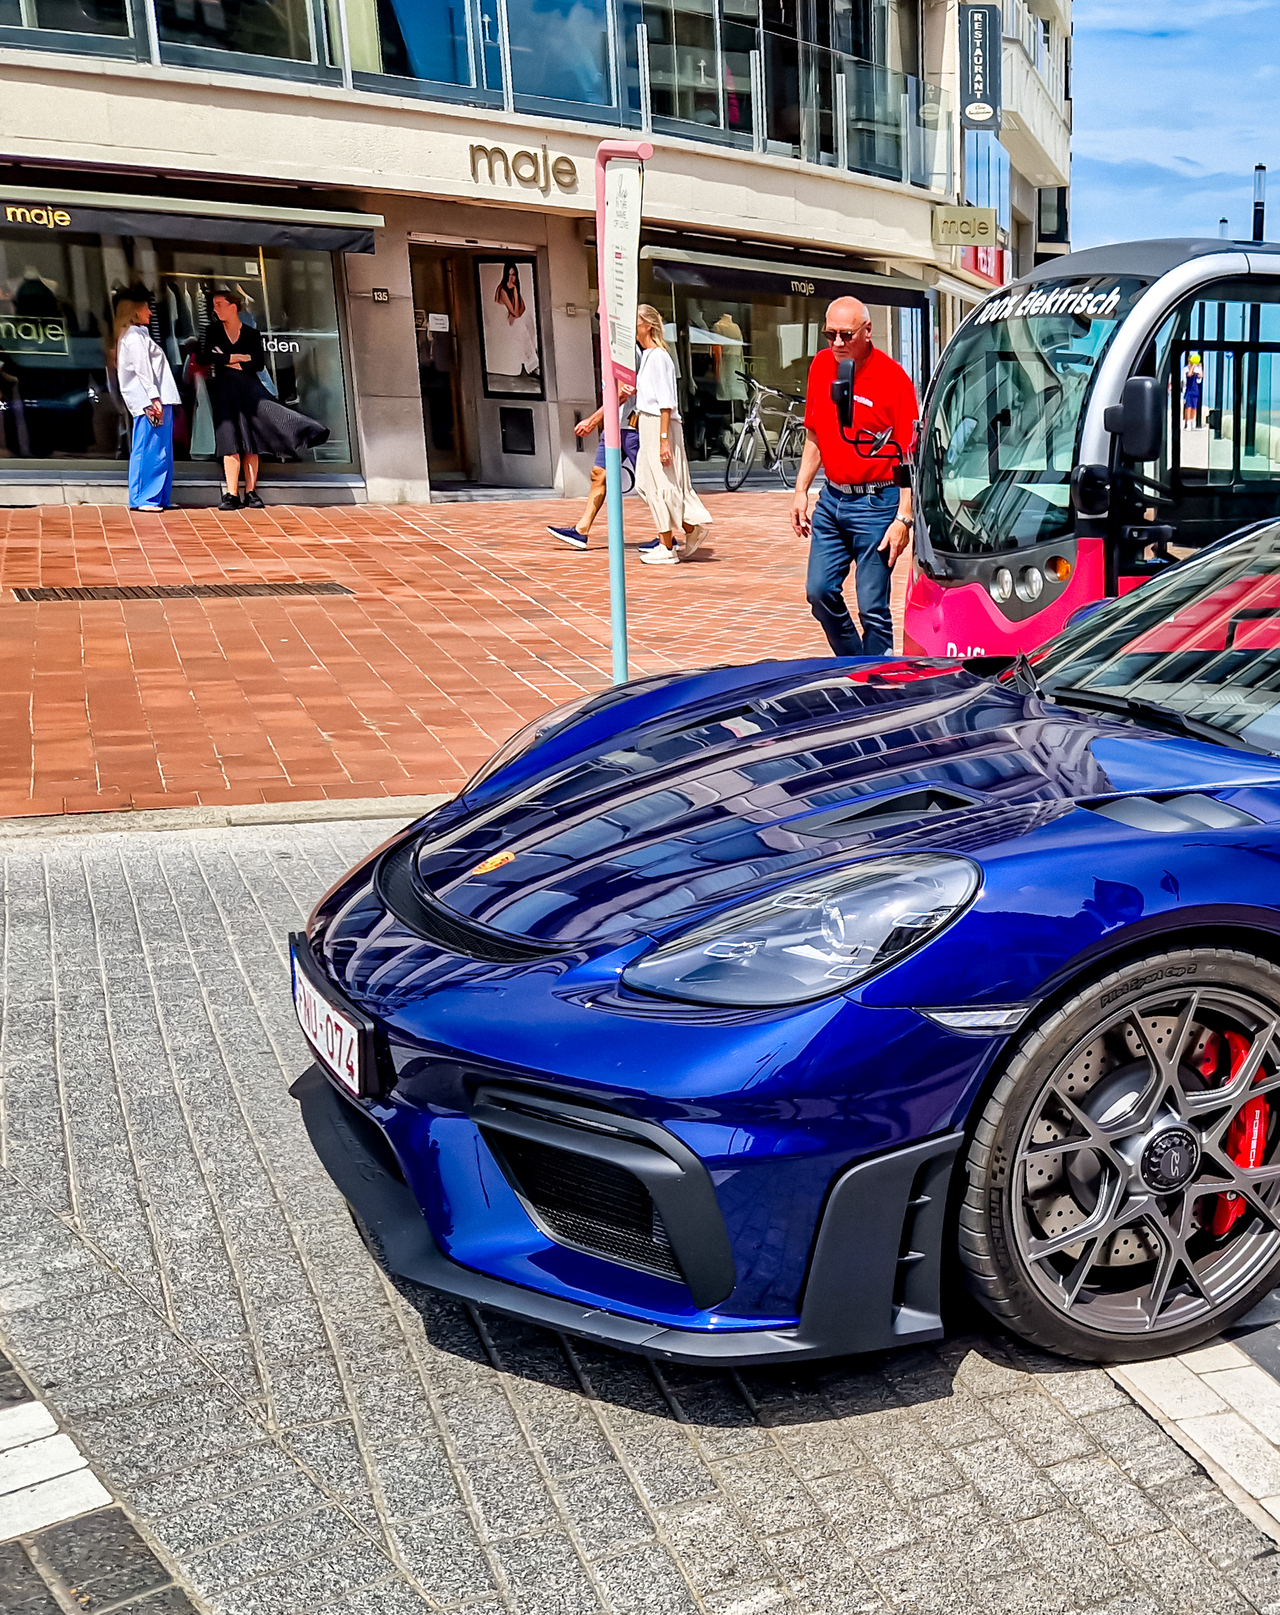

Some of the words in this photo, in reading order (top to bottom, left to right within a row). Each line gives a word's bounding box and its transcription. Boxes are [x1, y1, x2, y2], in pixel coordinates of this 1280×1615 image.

[973, 12, 984, 99] RESTAURANT
[468, 143, 578, 193] maje
[5, 205, 72, 229] maje
[940, 217, 990, 239] maje
[373, 291, 389, 302] 135
[790, 279, 816, 297] maje
[973, 292, 1023, 326] 100%
[1014, 286, 1122, 317] Elektrisch
